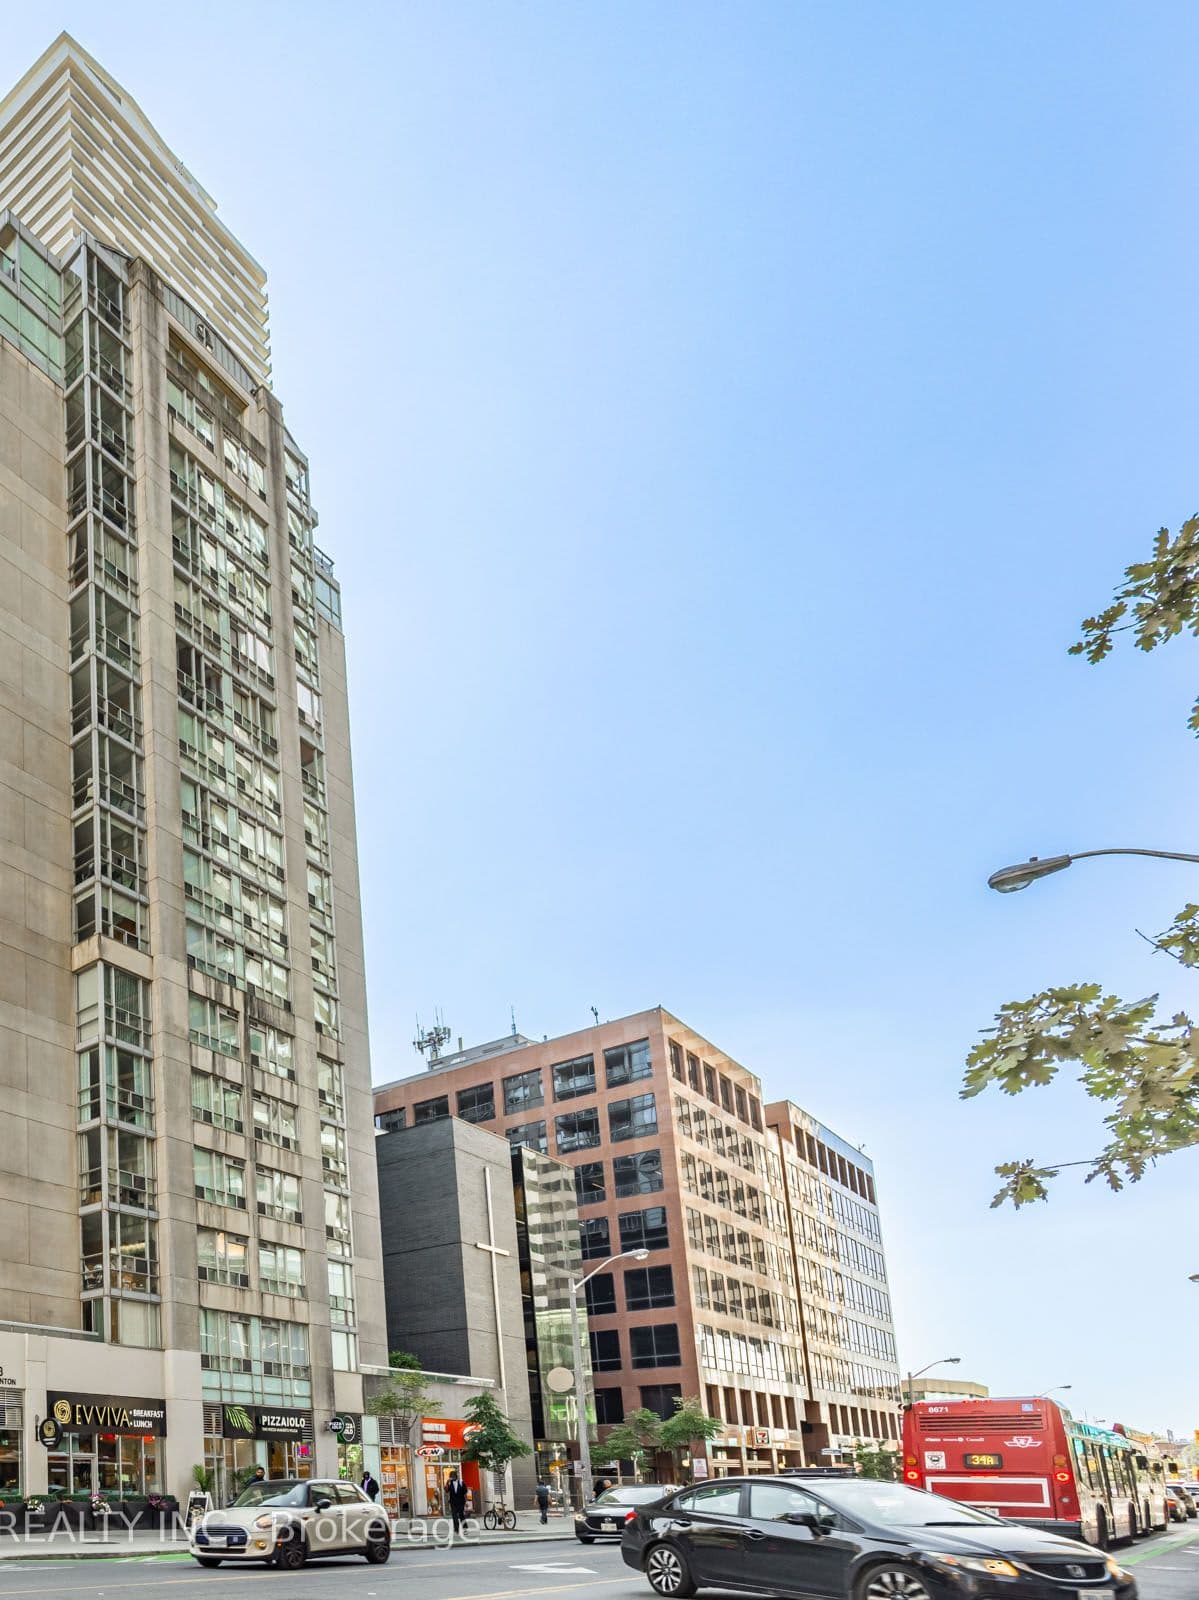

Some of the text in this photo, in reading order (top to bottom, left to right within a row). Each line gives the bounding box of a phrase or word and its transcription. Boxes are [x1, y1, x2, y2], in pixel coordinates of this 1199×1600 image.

[75, 1404, 131, 1428] EVVIVA
[133, 1408, 164, 1419] BREAKFAST
[133, 1420, 153, 1429] LUNCH
[261, 1415, 306, 1428] PIZZAIOLO
[970, 1455, 994, 1465] 34A
